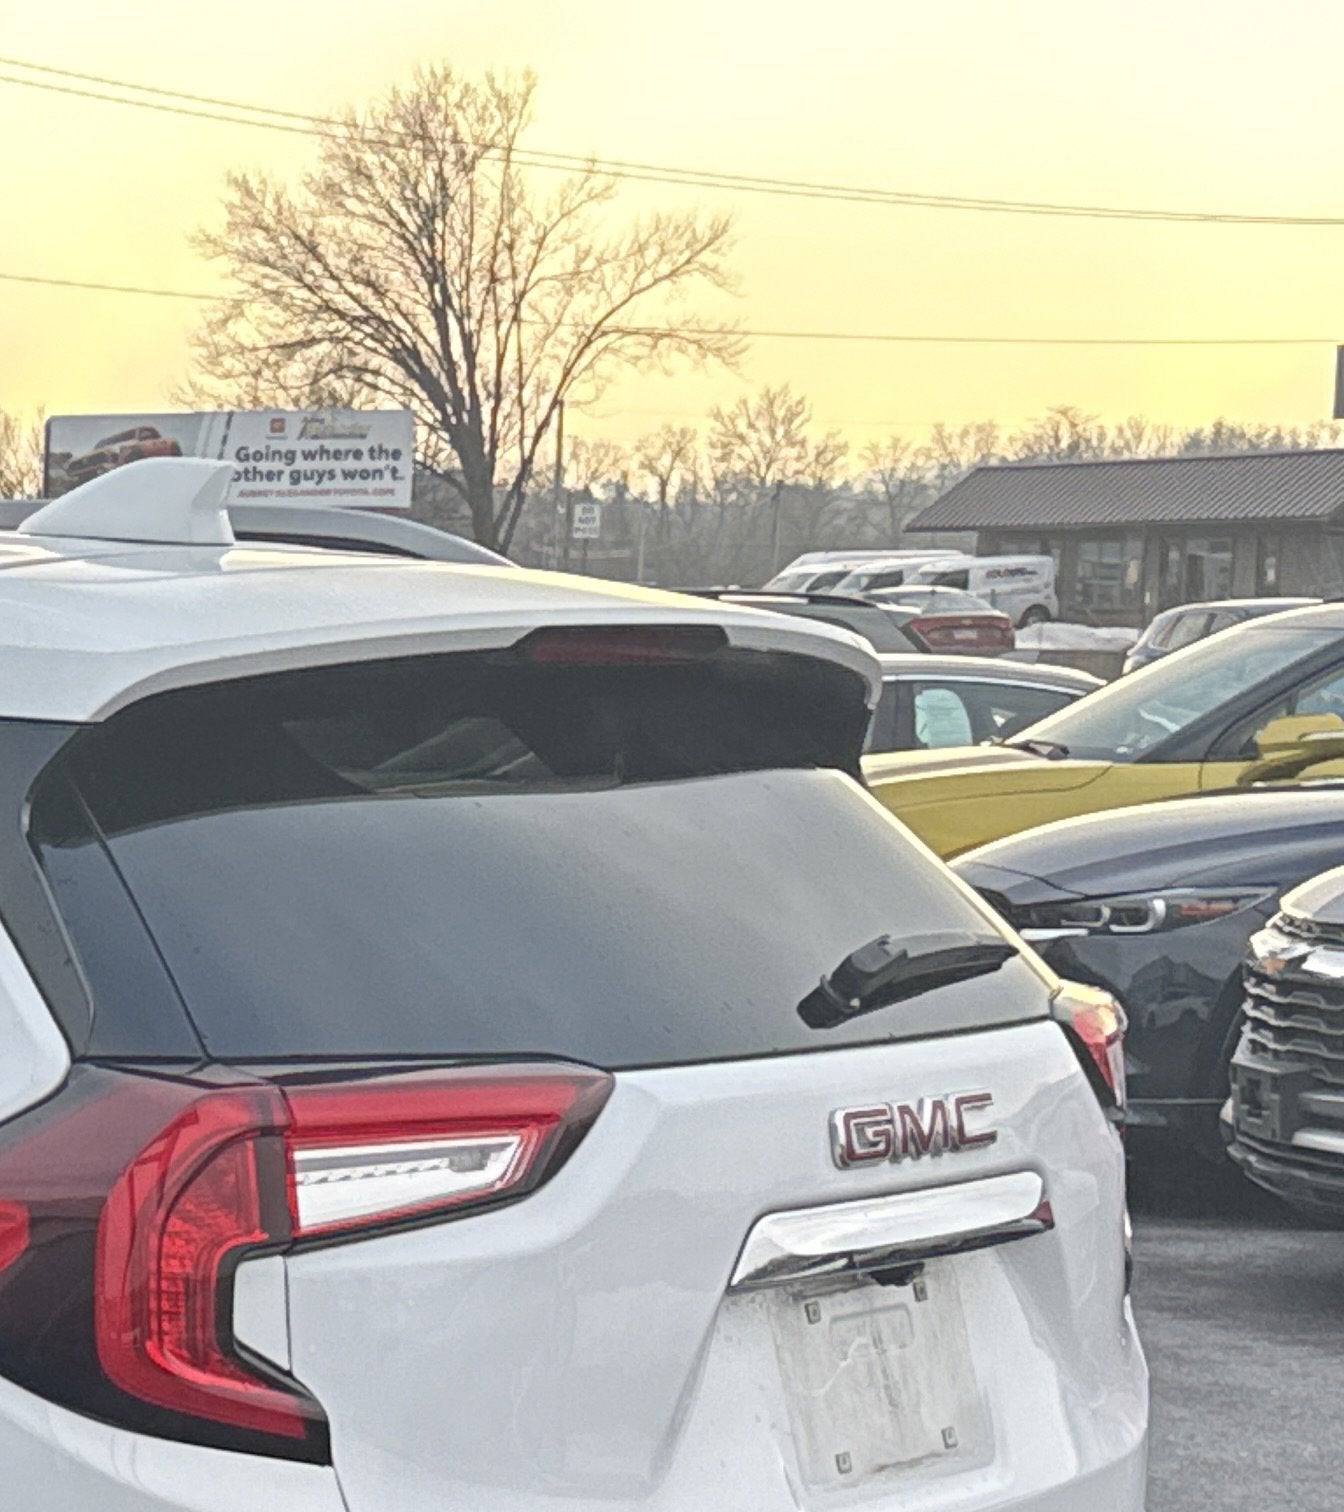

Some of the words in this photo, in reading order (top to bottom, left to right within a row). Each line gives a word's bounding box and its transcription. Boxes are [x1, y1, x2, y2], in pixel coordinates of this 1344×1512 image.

[235, 446, 297, 466] Going
[301, 445, 364, 462] where
[368, 443, 403, 462] the
[289, 468, 336, 486] guys
[341, 464, 405, 482] won't.
[828, 1087, 998, 1170] GMC
